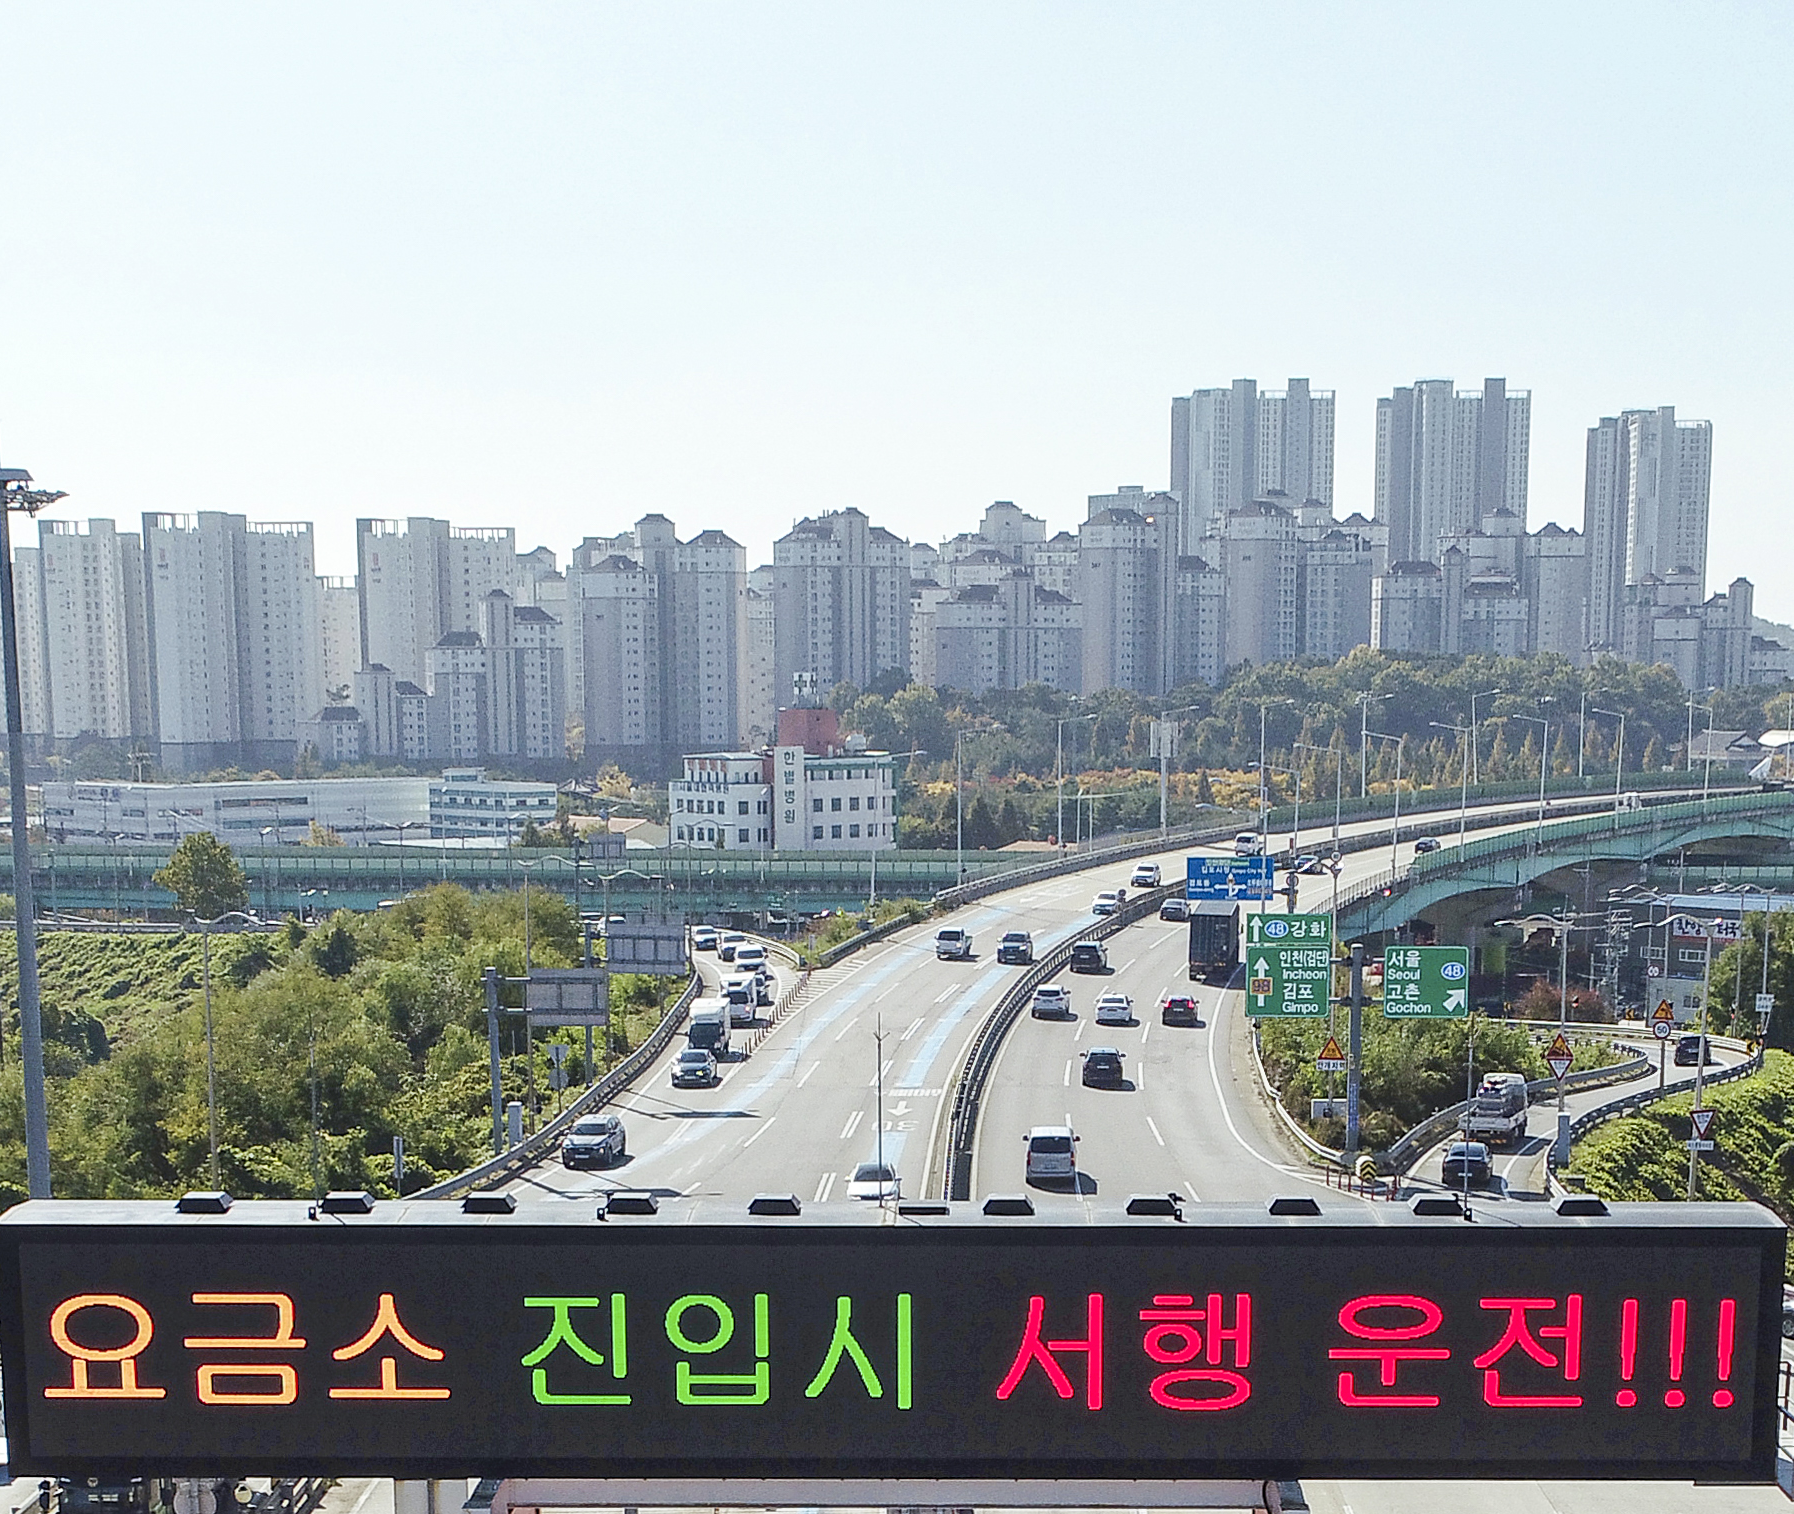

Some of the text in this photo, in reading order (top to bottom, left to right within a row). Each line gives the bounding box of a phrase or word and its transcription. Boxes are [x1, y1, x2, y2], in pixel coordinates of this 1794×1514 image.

[1266, 921, 1326, 938] 48 강화
[1279, 950, 1328, 968] 인천(검단)
[1387, 951, 1422, 968] 서울
[1282, 969, 1327, 979] Incheon
[1387, 969, 1421, 980] Seoul
[1443, 966, 1463, 976] 48
[1282, 983, 1314, 1000] 김포
[1386, 984, 1421, 1000] 고촌
[1282, 1003, 1319, 1014] Gimpo
[1386, 1002, 1432, 1014] Gochon
[45, 1289, 1737, 1413] 요금소 진입시 서행 운전!!!
